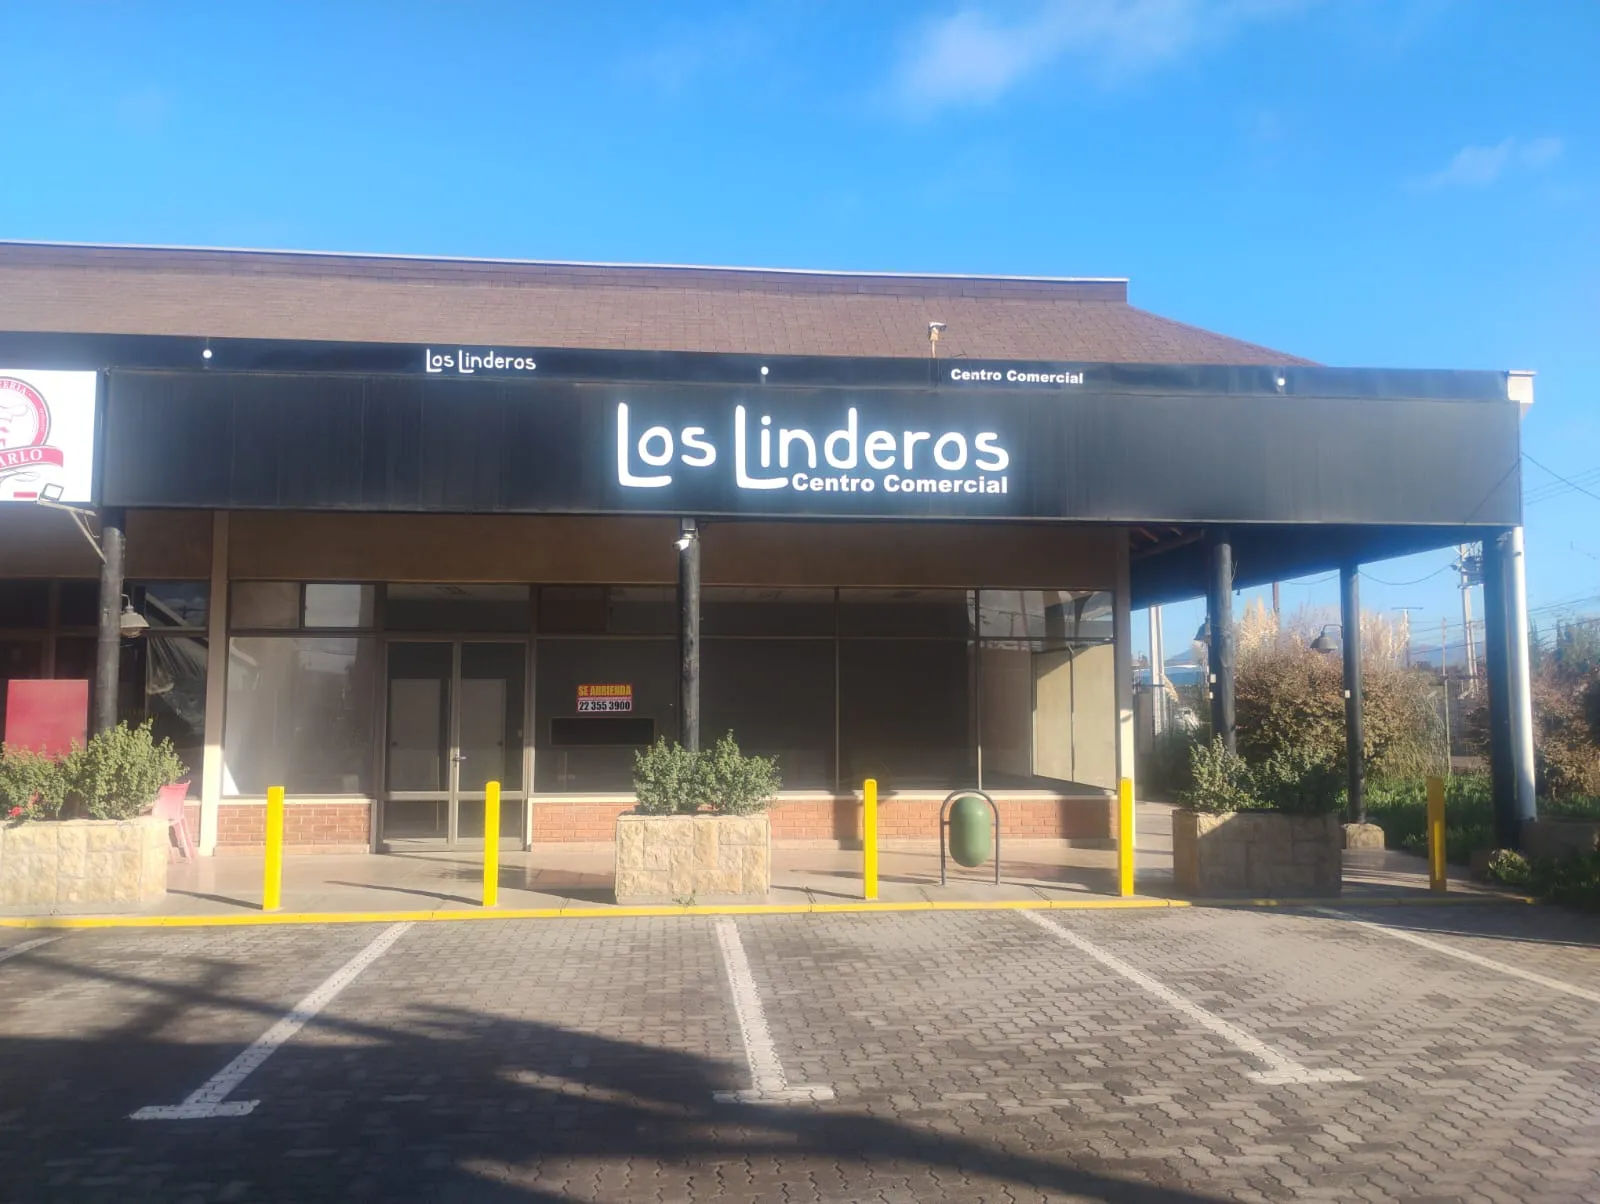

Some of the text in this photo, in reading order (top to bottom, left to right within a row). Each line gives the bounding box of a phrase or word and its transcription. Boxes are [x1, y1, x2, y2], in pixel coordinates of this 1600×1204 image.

[426, 348, 536, 374] Los Linderos
[950, 368, 1084, 384] Centro Comercial
[617, 402, 1010, 490] Los Linderos
[791, 472, 1008, 494] Centro Comercial
[578, 685, 588, 696] SE
[579, 701, 631, 710] 22 355 3900
